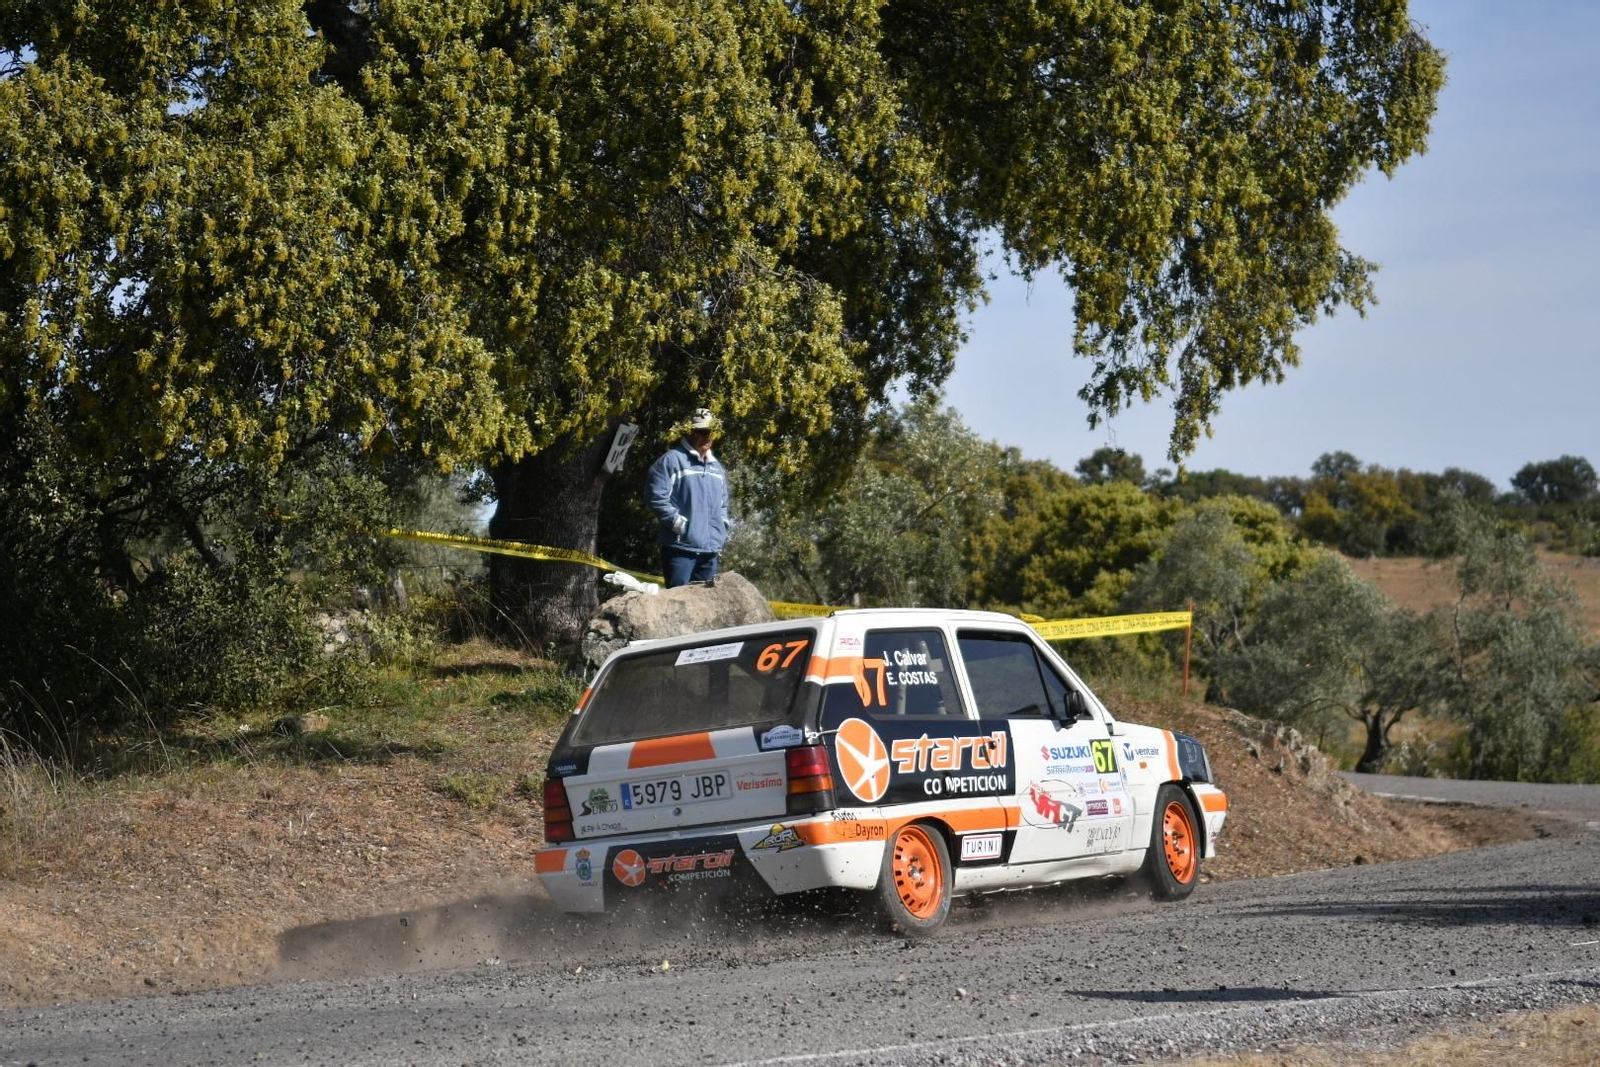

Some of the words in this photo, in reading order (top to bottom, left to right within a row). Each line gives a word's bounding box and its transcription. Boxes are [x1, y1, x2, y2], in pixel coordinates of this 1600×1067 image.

[756, 639, 809, 672] 67
[894, 650, 927, 667] Calvar
[886, 672, 898, 685] E.
[899, 671, 938, 685] COSTAS
[891, 730, 1007, 774] staroil
[1051, 746, 1091, 760] SUZUKI
[1091, 740, 1115, 773] 67
[1135, 747, 1160, 757] ventair
[632, 780, 682, 806] 5979
[691, 774, 726, 799] JBP
[856, 823, 884, 840] Dayron
[966, 841, 998, 854] TURINI
[646, 849, 735, 875] staroil
[668, 867, 731, 882] COMPETICIÓN
